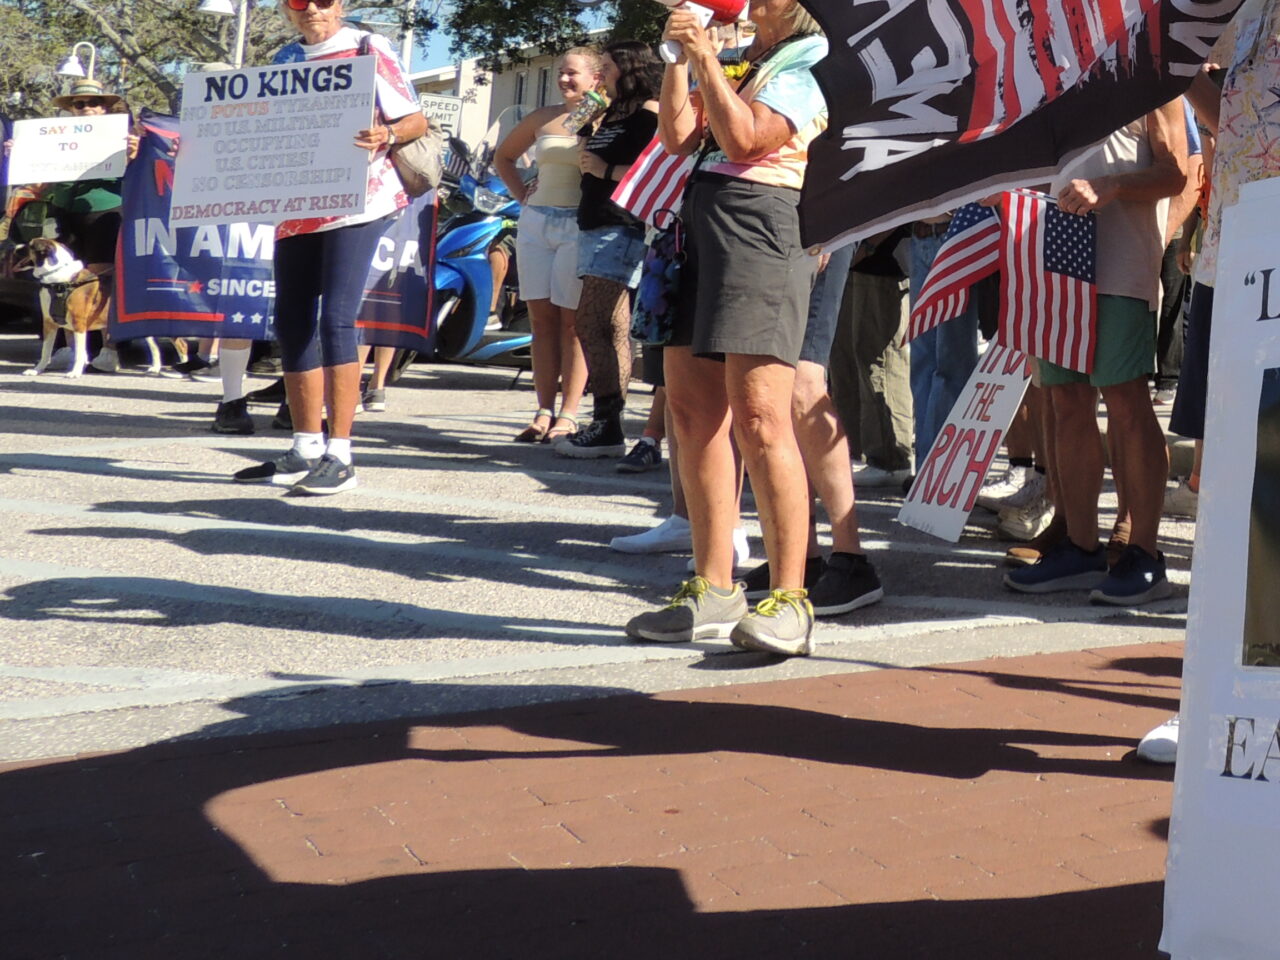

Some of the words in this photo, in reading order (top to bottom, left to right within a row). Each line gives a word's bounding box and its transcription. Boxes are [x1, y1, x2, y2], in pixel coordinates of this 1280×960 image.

[204, 75, 249, 102] NO
[257, 63, 353, 98] KINGS
[182, 106, 207, 122] NO
[210, 101, 270, 119] POTUS
[422, 100, 459, 112] SPEED
[425, 112, 453, 121] LIMIT
[39, 126, 67, 135] SAY
[73, 123, 93, 133] NO
[197, 122, 223, 138] NO
[254, 113, 343, 134] MILITARY
[58, 141, 79, 151] TO
[213, 133, 321, 155] OCCUPYING
[191, 176, 219, 193] NO
[171, 198, 282, 221] DEMOCRACY
[283, 197, 307, 213] AT
[309, 193, 360, 212] RISK!
[134, 217, 177, 256] IN
[207, 279, 276, 297] SINCE
[962, 382, 1005, 421] THE
[909, 423, 1002, 512] RICH
